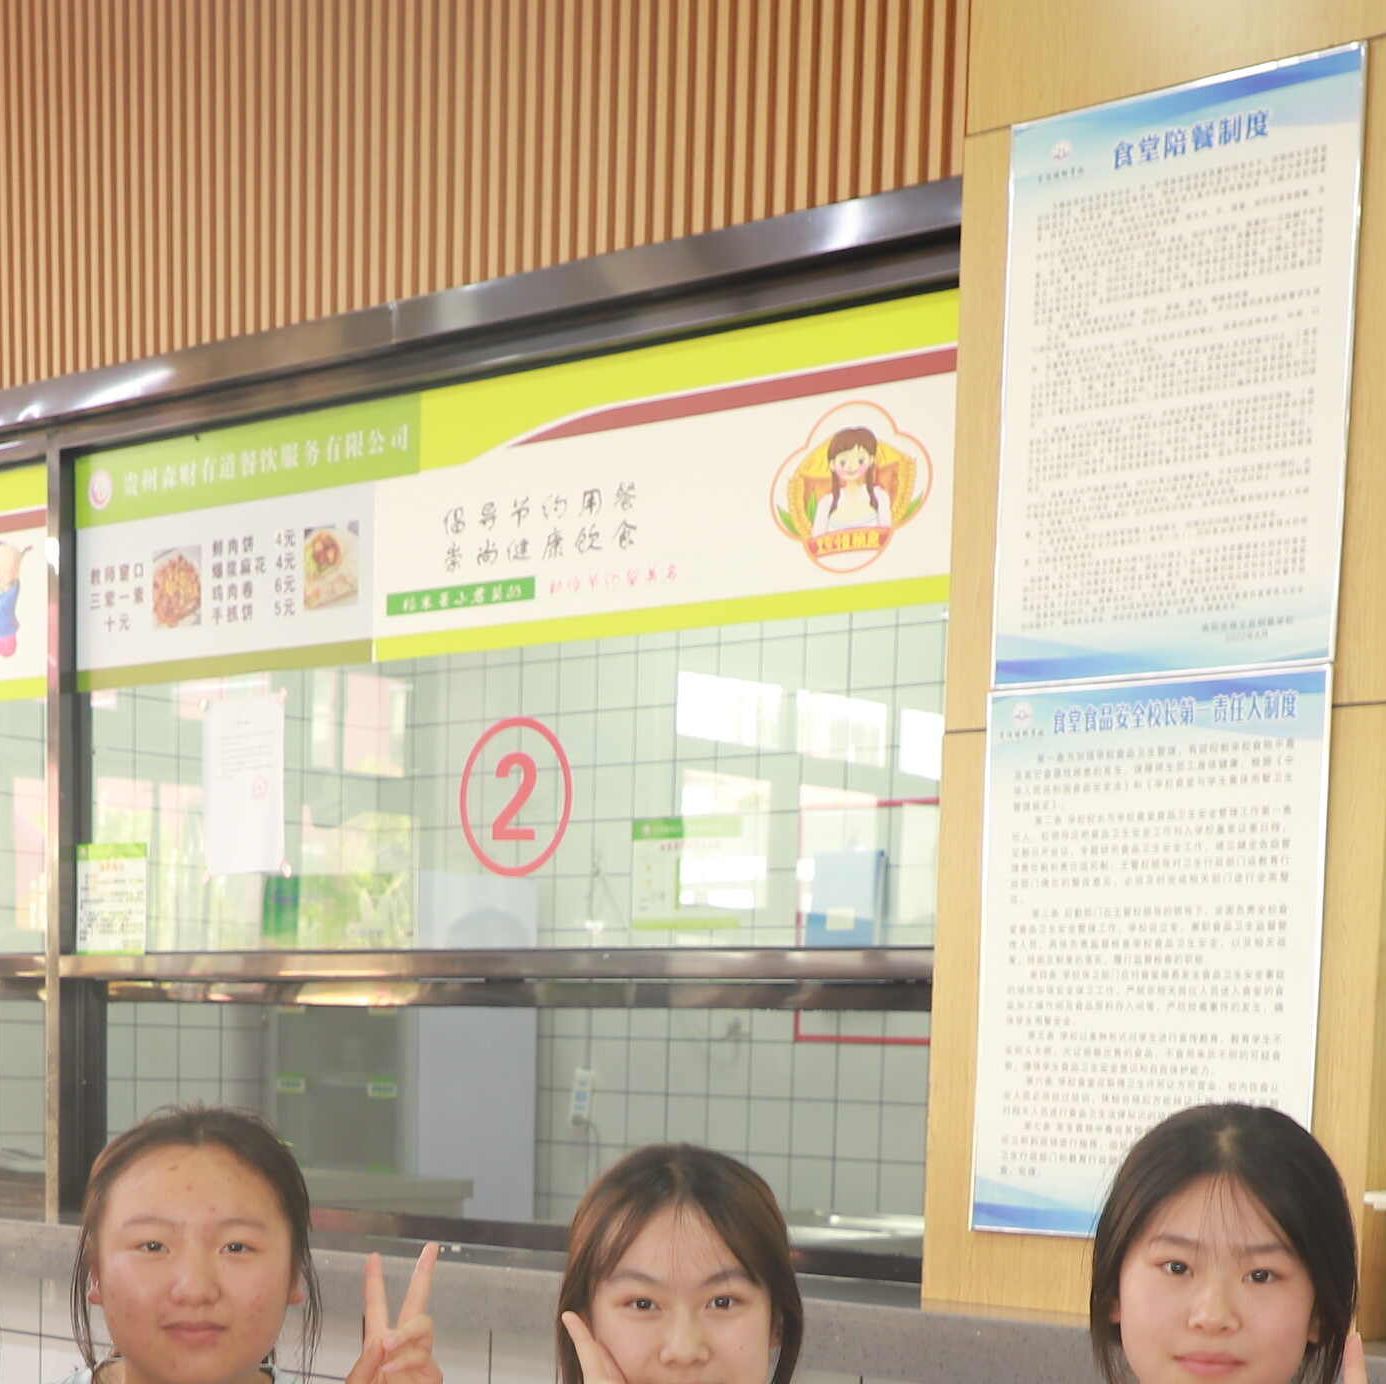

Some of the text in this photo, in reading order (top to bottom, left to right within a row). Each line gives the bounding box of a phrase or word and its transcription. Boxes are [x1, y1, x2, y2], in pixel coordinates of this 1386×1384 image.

[1113, 110, 1270, 170] 食堂陪餐制度
